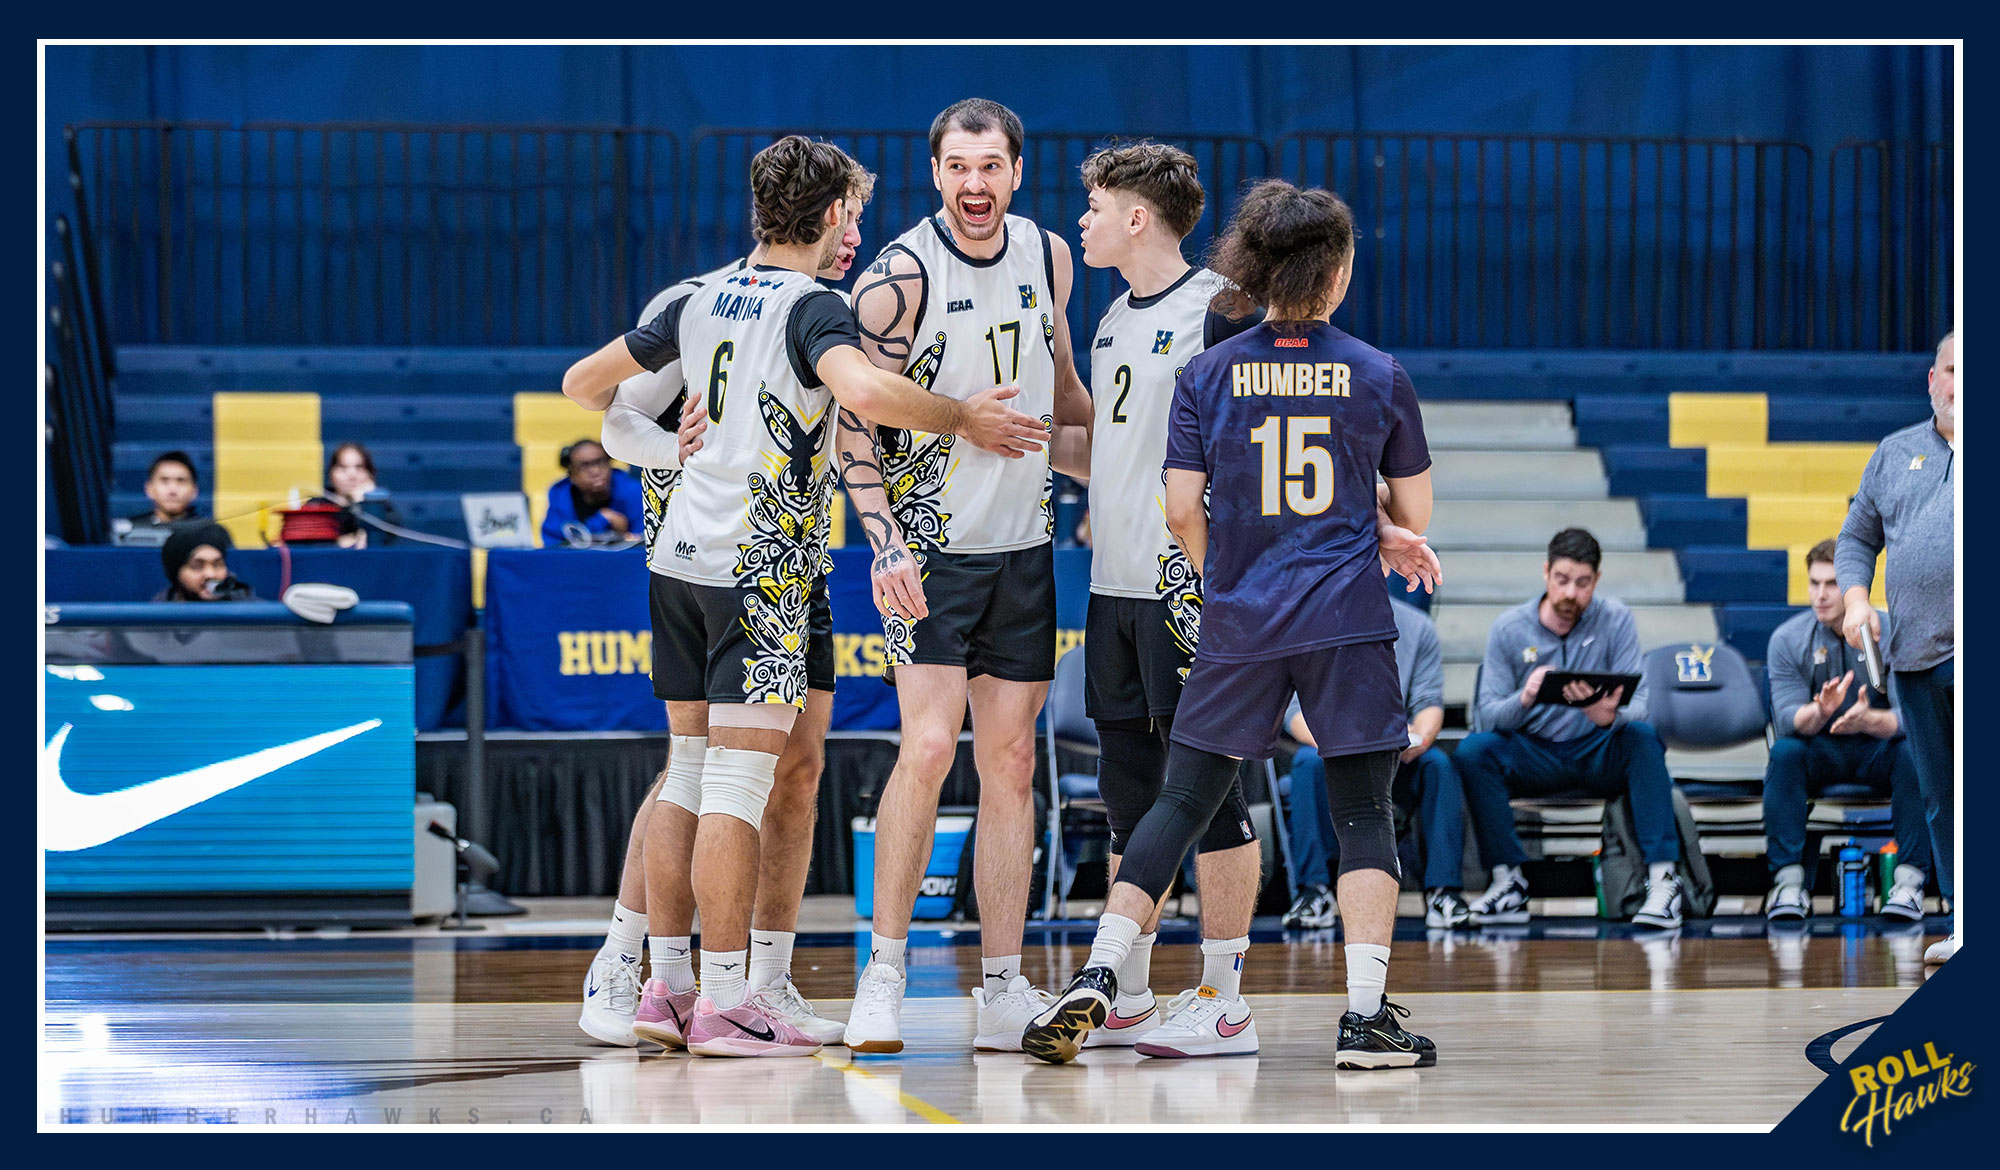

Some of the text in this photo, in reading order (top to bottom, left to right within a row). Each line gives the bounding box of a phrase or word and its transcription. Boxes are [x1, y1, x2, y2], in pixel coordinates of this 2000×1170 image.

[710, 292, 765, 321] MAINA
[985, 320, 1021, 386] 17
[1273, 338, 1309, 348] OCAA
[707, 339, 735, 425] 6
[1111, 363, 1132, 424] 2
[1232, 362, 1351, 397] HUMBER
[1250, 415, 1335, 516] 15
[557, 630, 653, 676] HUM
